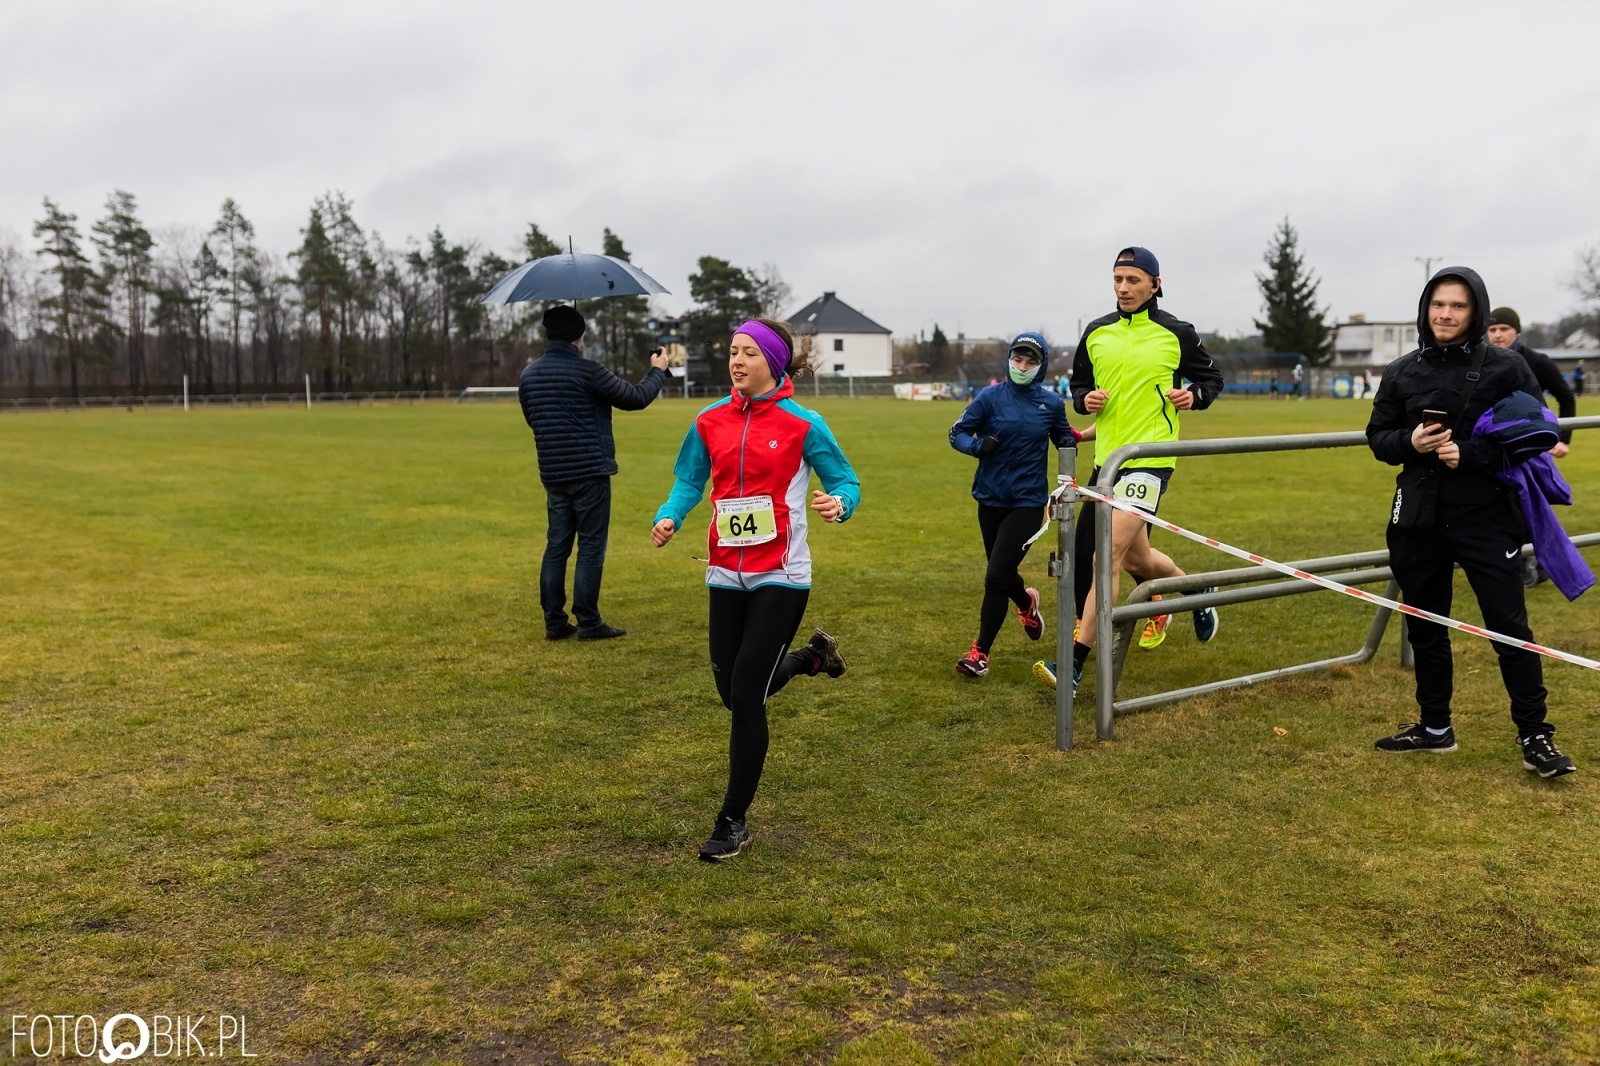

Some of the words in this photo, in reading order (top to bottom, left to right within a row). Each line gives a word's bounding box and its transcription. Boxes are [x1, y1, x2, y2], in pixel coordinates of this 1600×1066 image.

[1125, 482, 1147, 500] 69
[1392, 488, 1403, 524] adidas
[729, 513, 758, 537] 64
